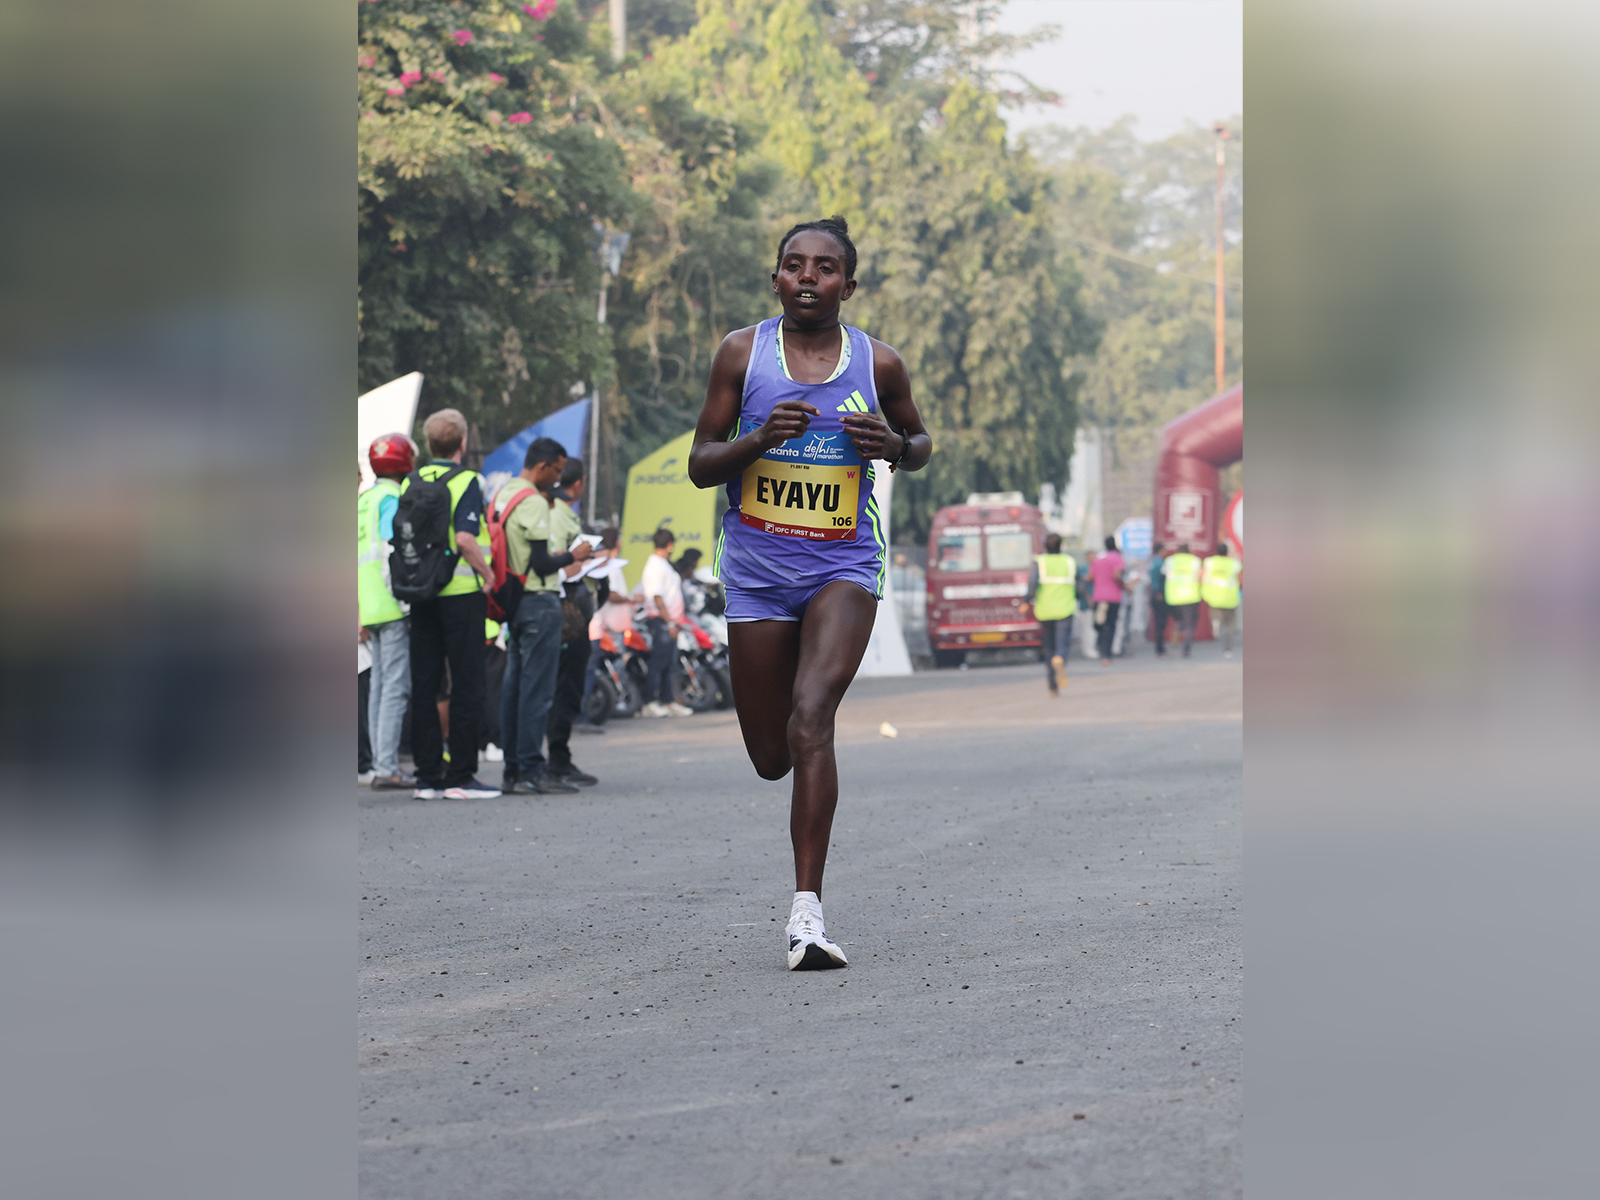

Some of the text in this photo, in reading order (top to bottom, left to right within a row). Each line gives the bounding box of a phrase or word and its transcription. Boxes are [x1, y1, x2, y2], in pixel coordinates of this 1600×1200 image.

[804, 438, 830, 460] delhi
[847, 471, 856, 479] W
[757, 475, 841, 512] EYAYU
[832, 516, 852, 527] 106
[774, 526, 790, 534] IDFC
[790, 528, 808, 536] FIRST
